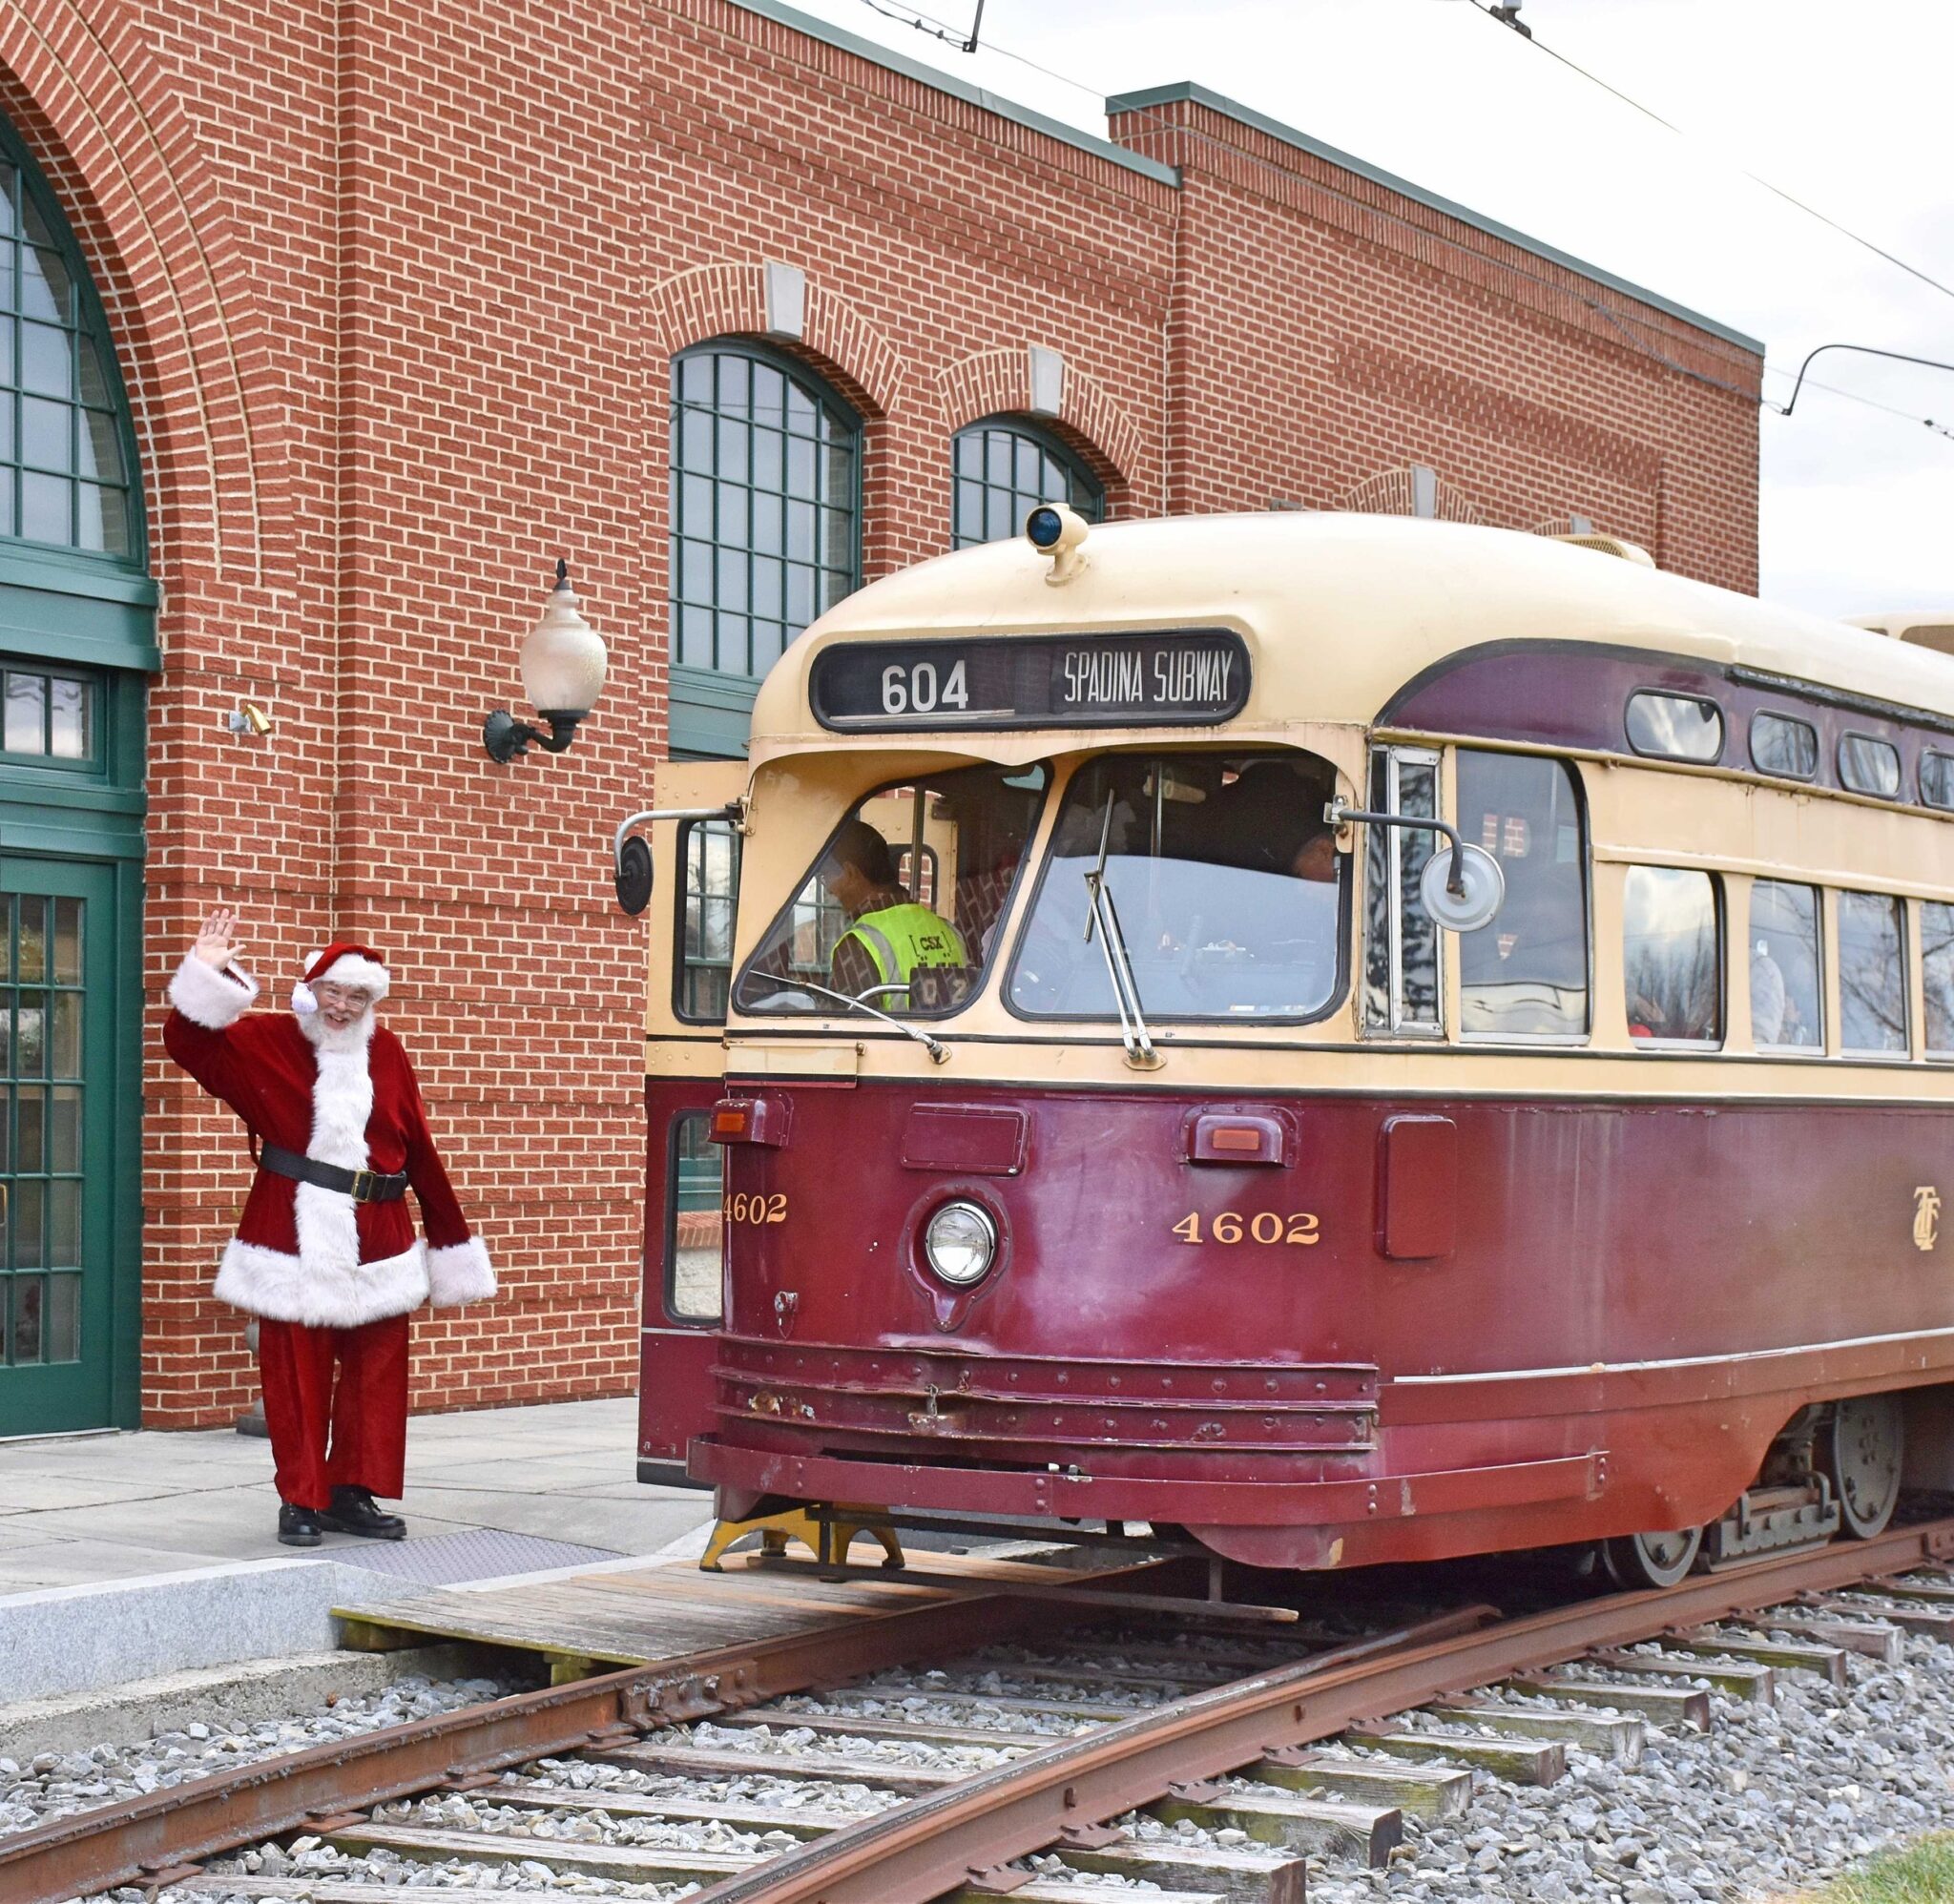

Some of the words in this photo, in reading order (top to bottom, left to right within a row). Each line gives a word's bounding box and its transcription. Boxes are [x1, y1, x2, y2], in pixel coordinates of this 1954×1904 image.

[883, 659, 968, 714] 604
[1064, 652, 1143, 703] SPADINA
[1154, 651, 1234, 702] SUBWAY
[919, 936, 944, 951] CSX
[723, 1192, 787, 1225] 4602
[1172, 1211, 1320, 1245] 4602
